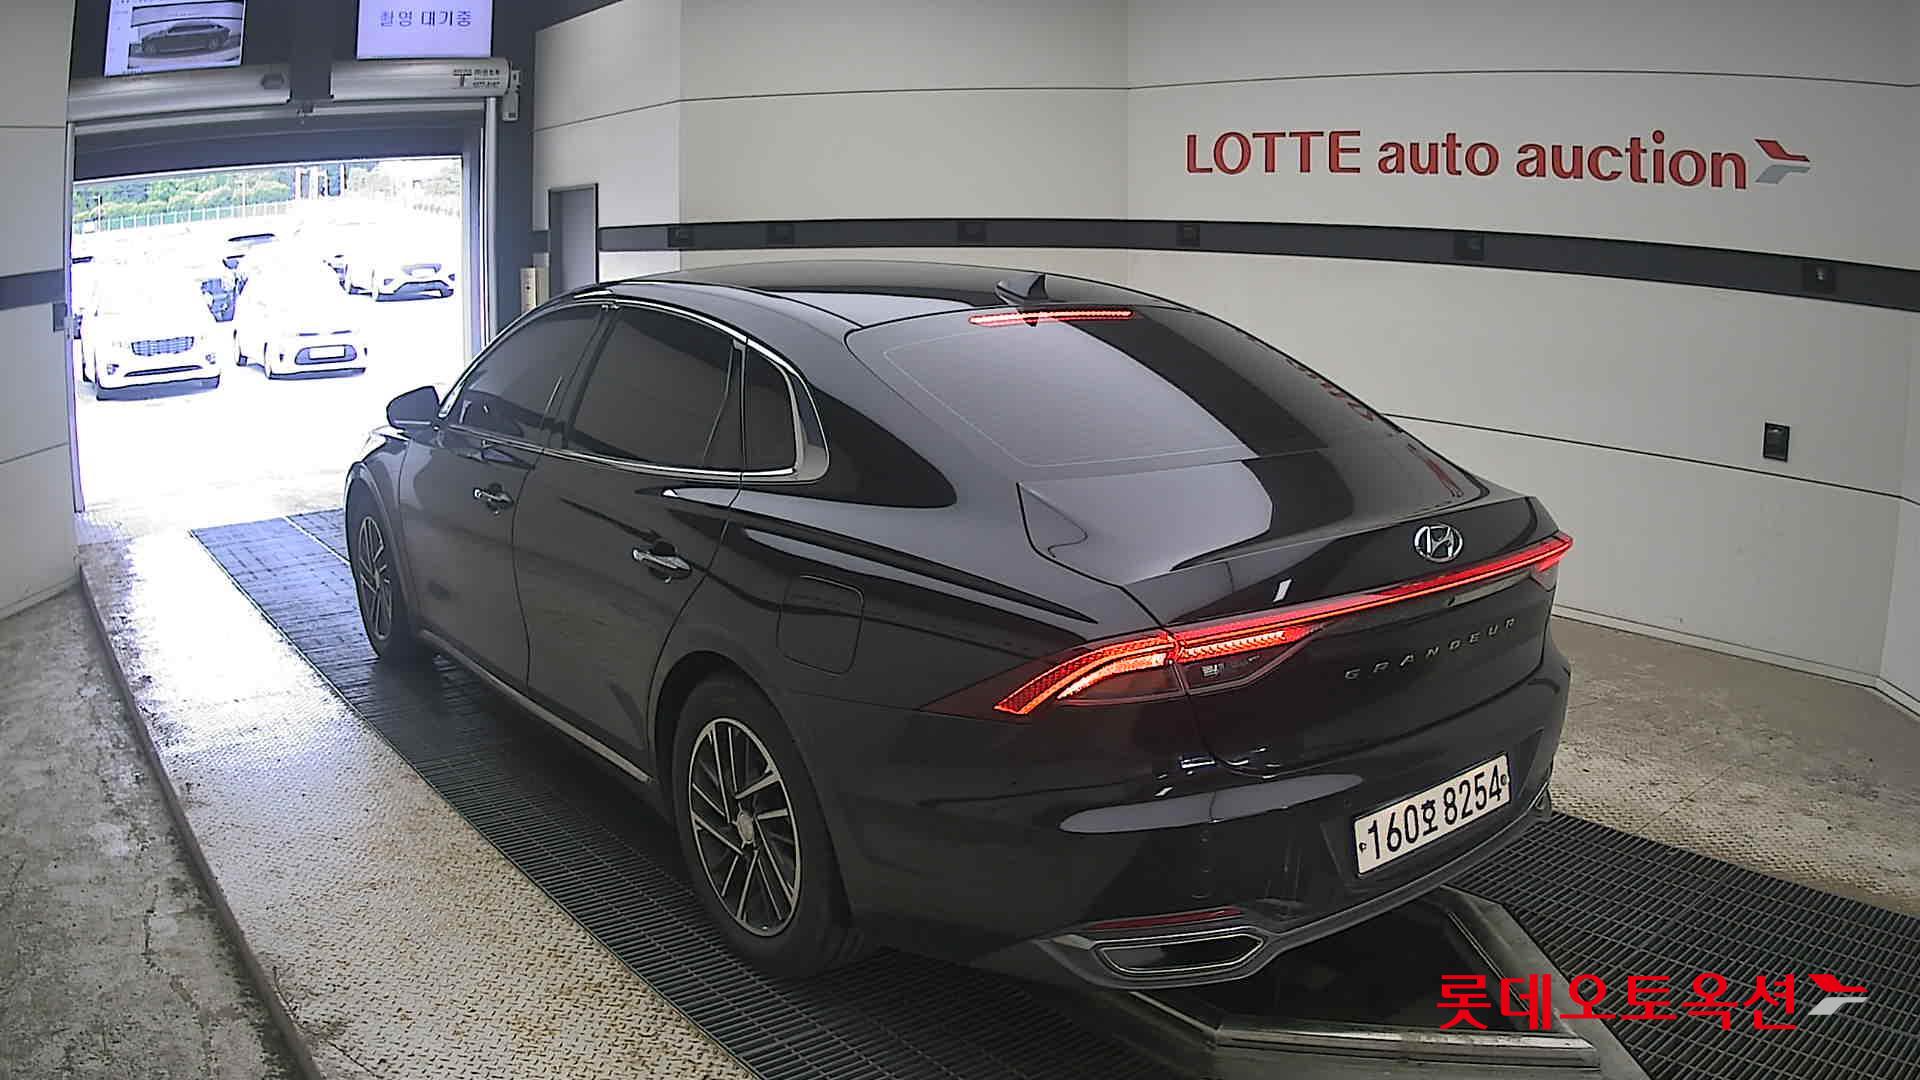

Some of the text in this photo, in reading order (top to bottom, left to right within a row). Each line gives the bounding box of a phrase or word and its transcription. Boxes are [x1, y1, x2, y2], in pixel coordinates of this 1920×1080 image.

[421, 9, 472, 28] 대기중
[1186, 130, 1747, 190] LOTTE auto auction
[1344, 617, 1516, 680] GRANDEUR
[1367, 764, 1502, 860] 160호 8254
